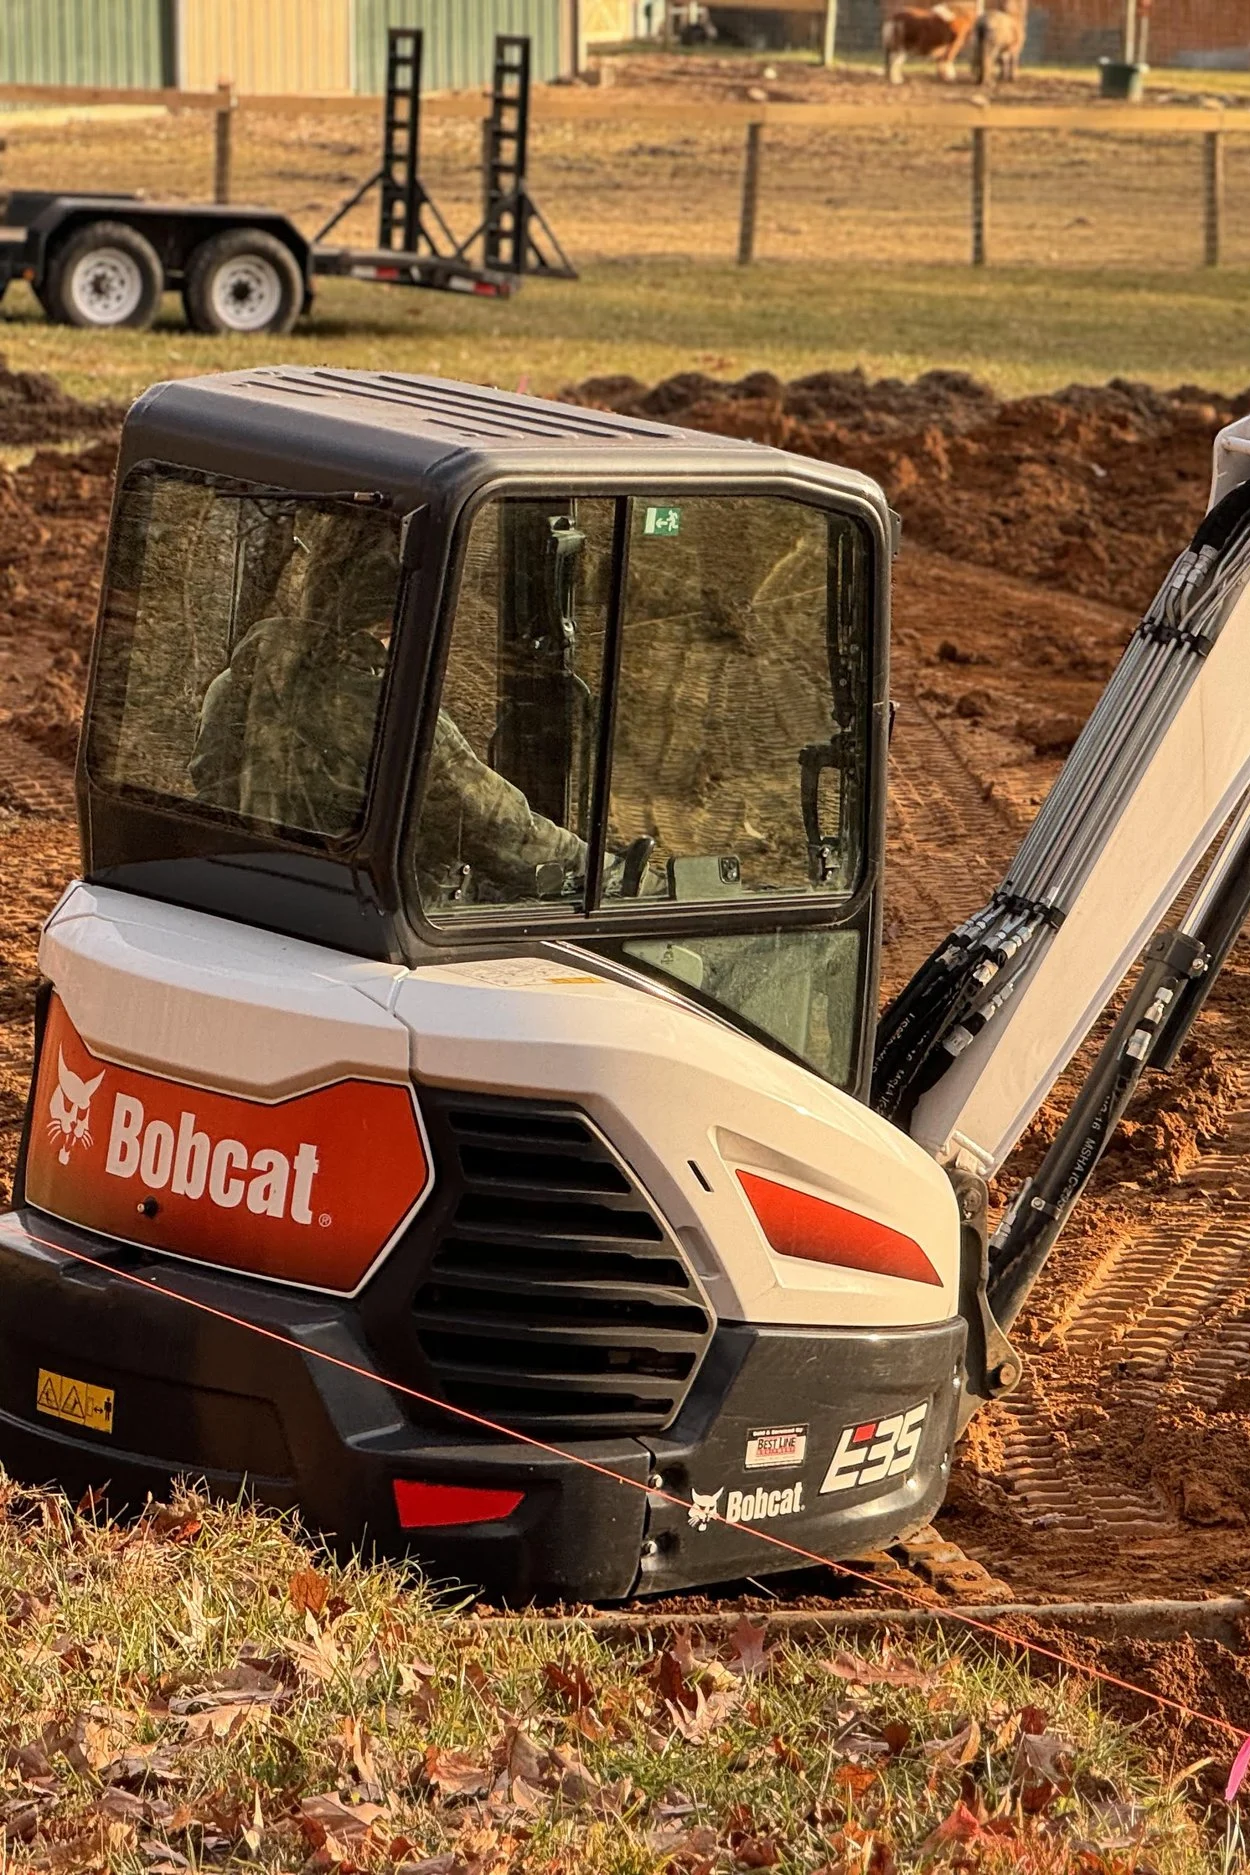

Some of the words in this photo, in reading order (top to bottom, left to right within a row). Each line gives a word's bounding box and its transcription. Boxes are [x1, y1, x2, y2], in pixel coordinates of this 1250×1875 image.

[105, 1092, 319, 1225] Bobcat
[1075, 1137, 1096, 1173] MSHA
[758, 1439, 777, 1449] BEST
[779, 1436, 796, 1447] LINE
[819, 1402, 928, 1494] E35
[725, 1482, 803, 1523] Bobcat
